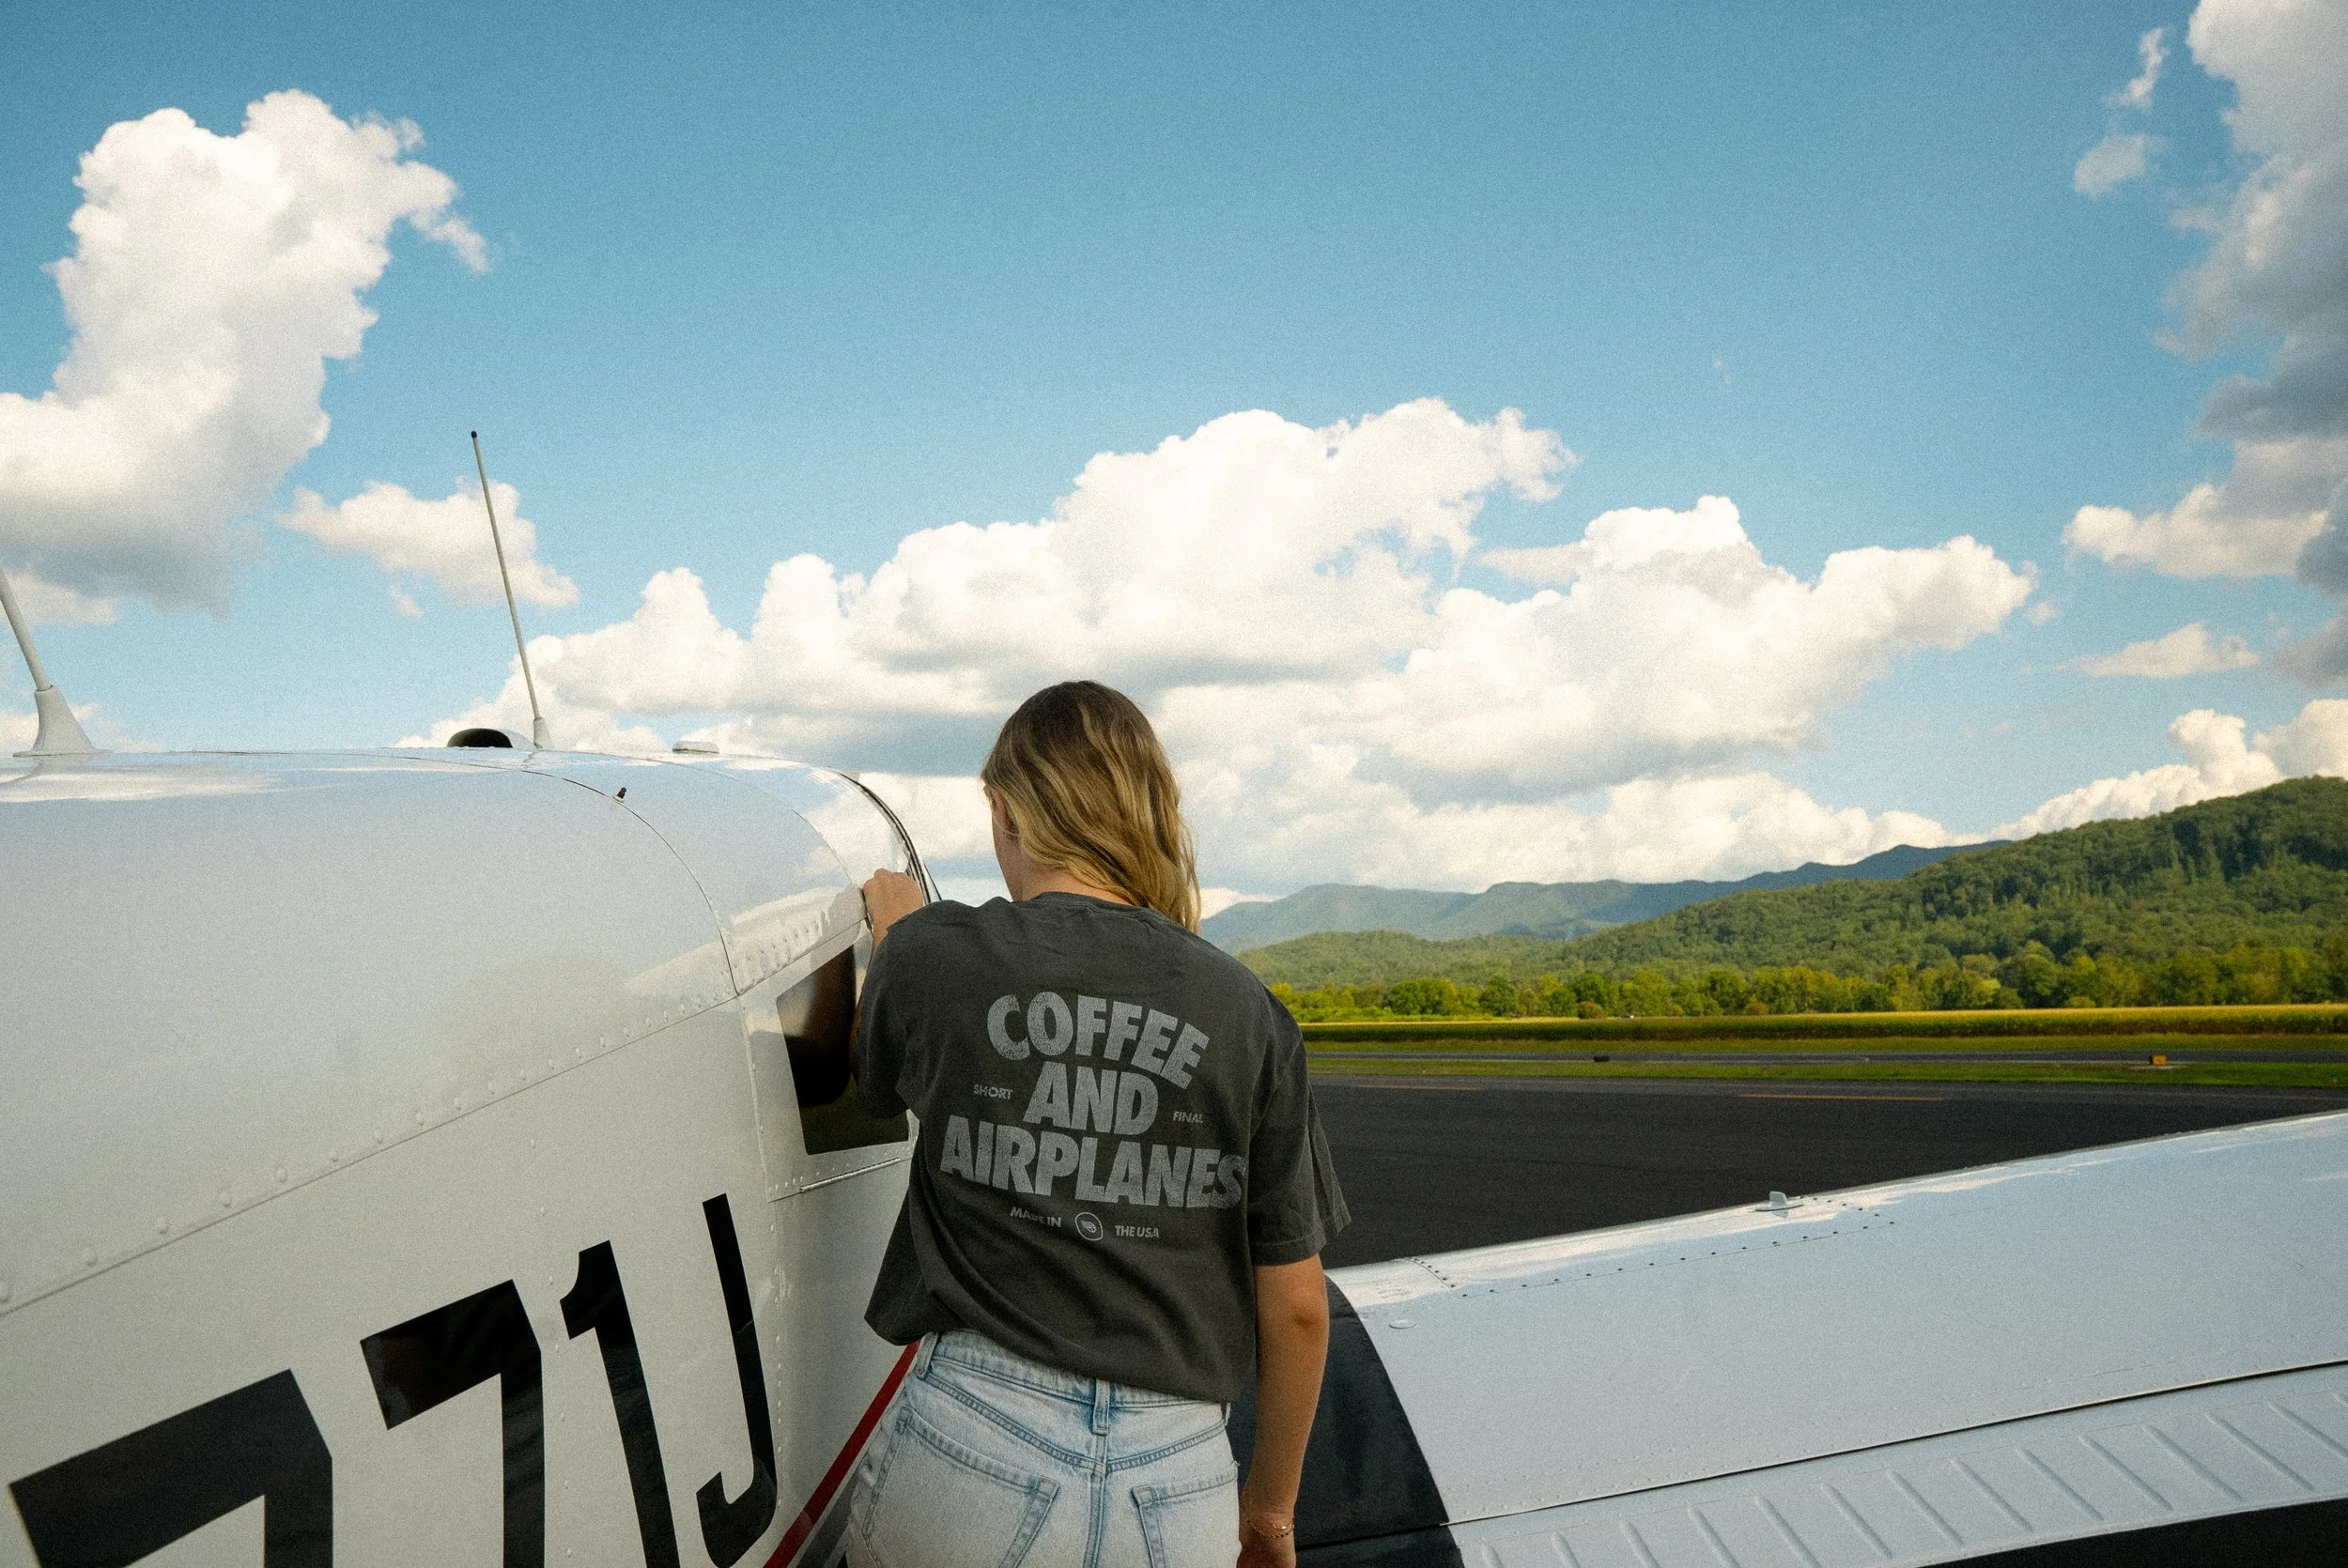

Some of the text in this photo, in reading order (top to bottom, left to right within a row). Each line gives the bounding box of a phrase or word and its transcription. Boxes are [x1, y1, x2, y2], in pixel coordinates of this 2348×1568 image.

[987, 992, 1210, 1089] COFFEE
[973, 1084, 1012, 1099] SHORT
[1023, 1062, 1158, 1135] AND
[1172, 1111, 1203, 1123] FINAL
[939, 1115, 1246, 1208] AIRPLANES
[1046, 1216, 1062, 1228] IN
[1115, 1224, 1135, 1237] THE
[1136, 1226, 1160, 1238] USA
